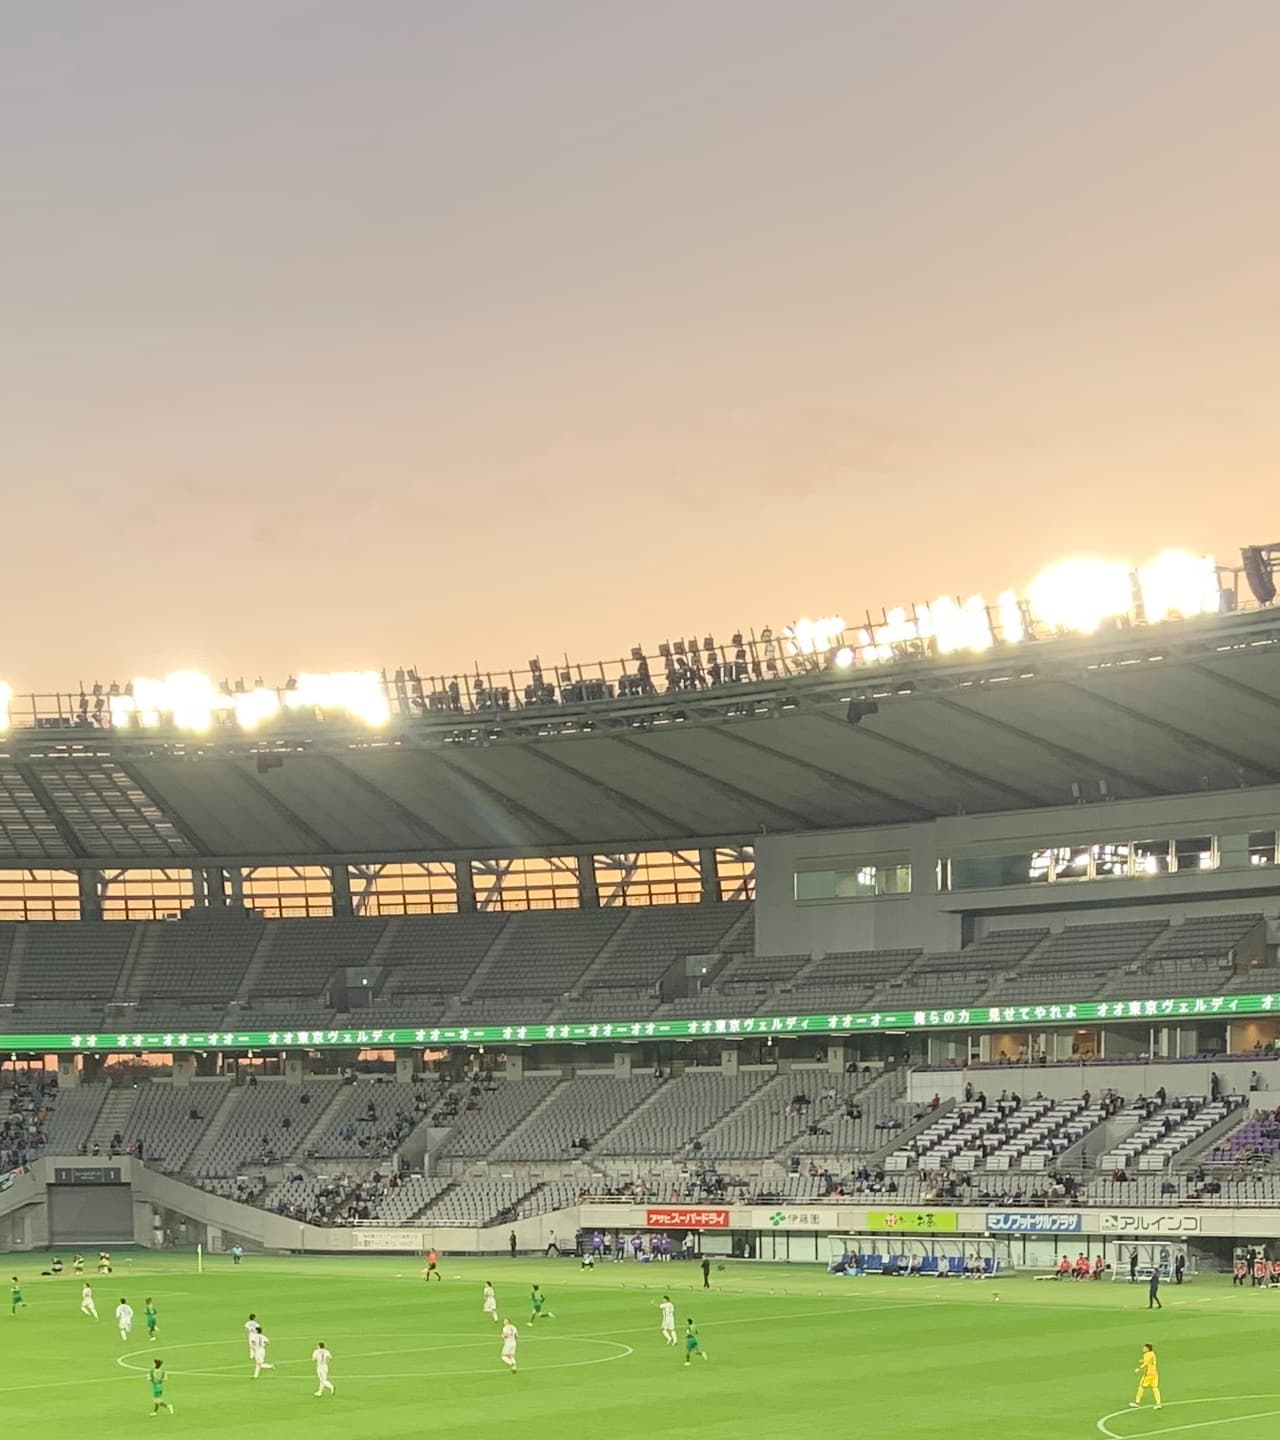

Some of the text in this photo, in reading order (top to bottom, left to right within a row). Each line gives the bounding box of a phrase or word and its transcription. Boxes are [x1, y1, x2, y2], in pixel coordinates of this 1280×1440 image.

[648, 1212, 726, 1225] アサヒスーパードライ
[1120, 1216, 1198, 1231] アルインコ
